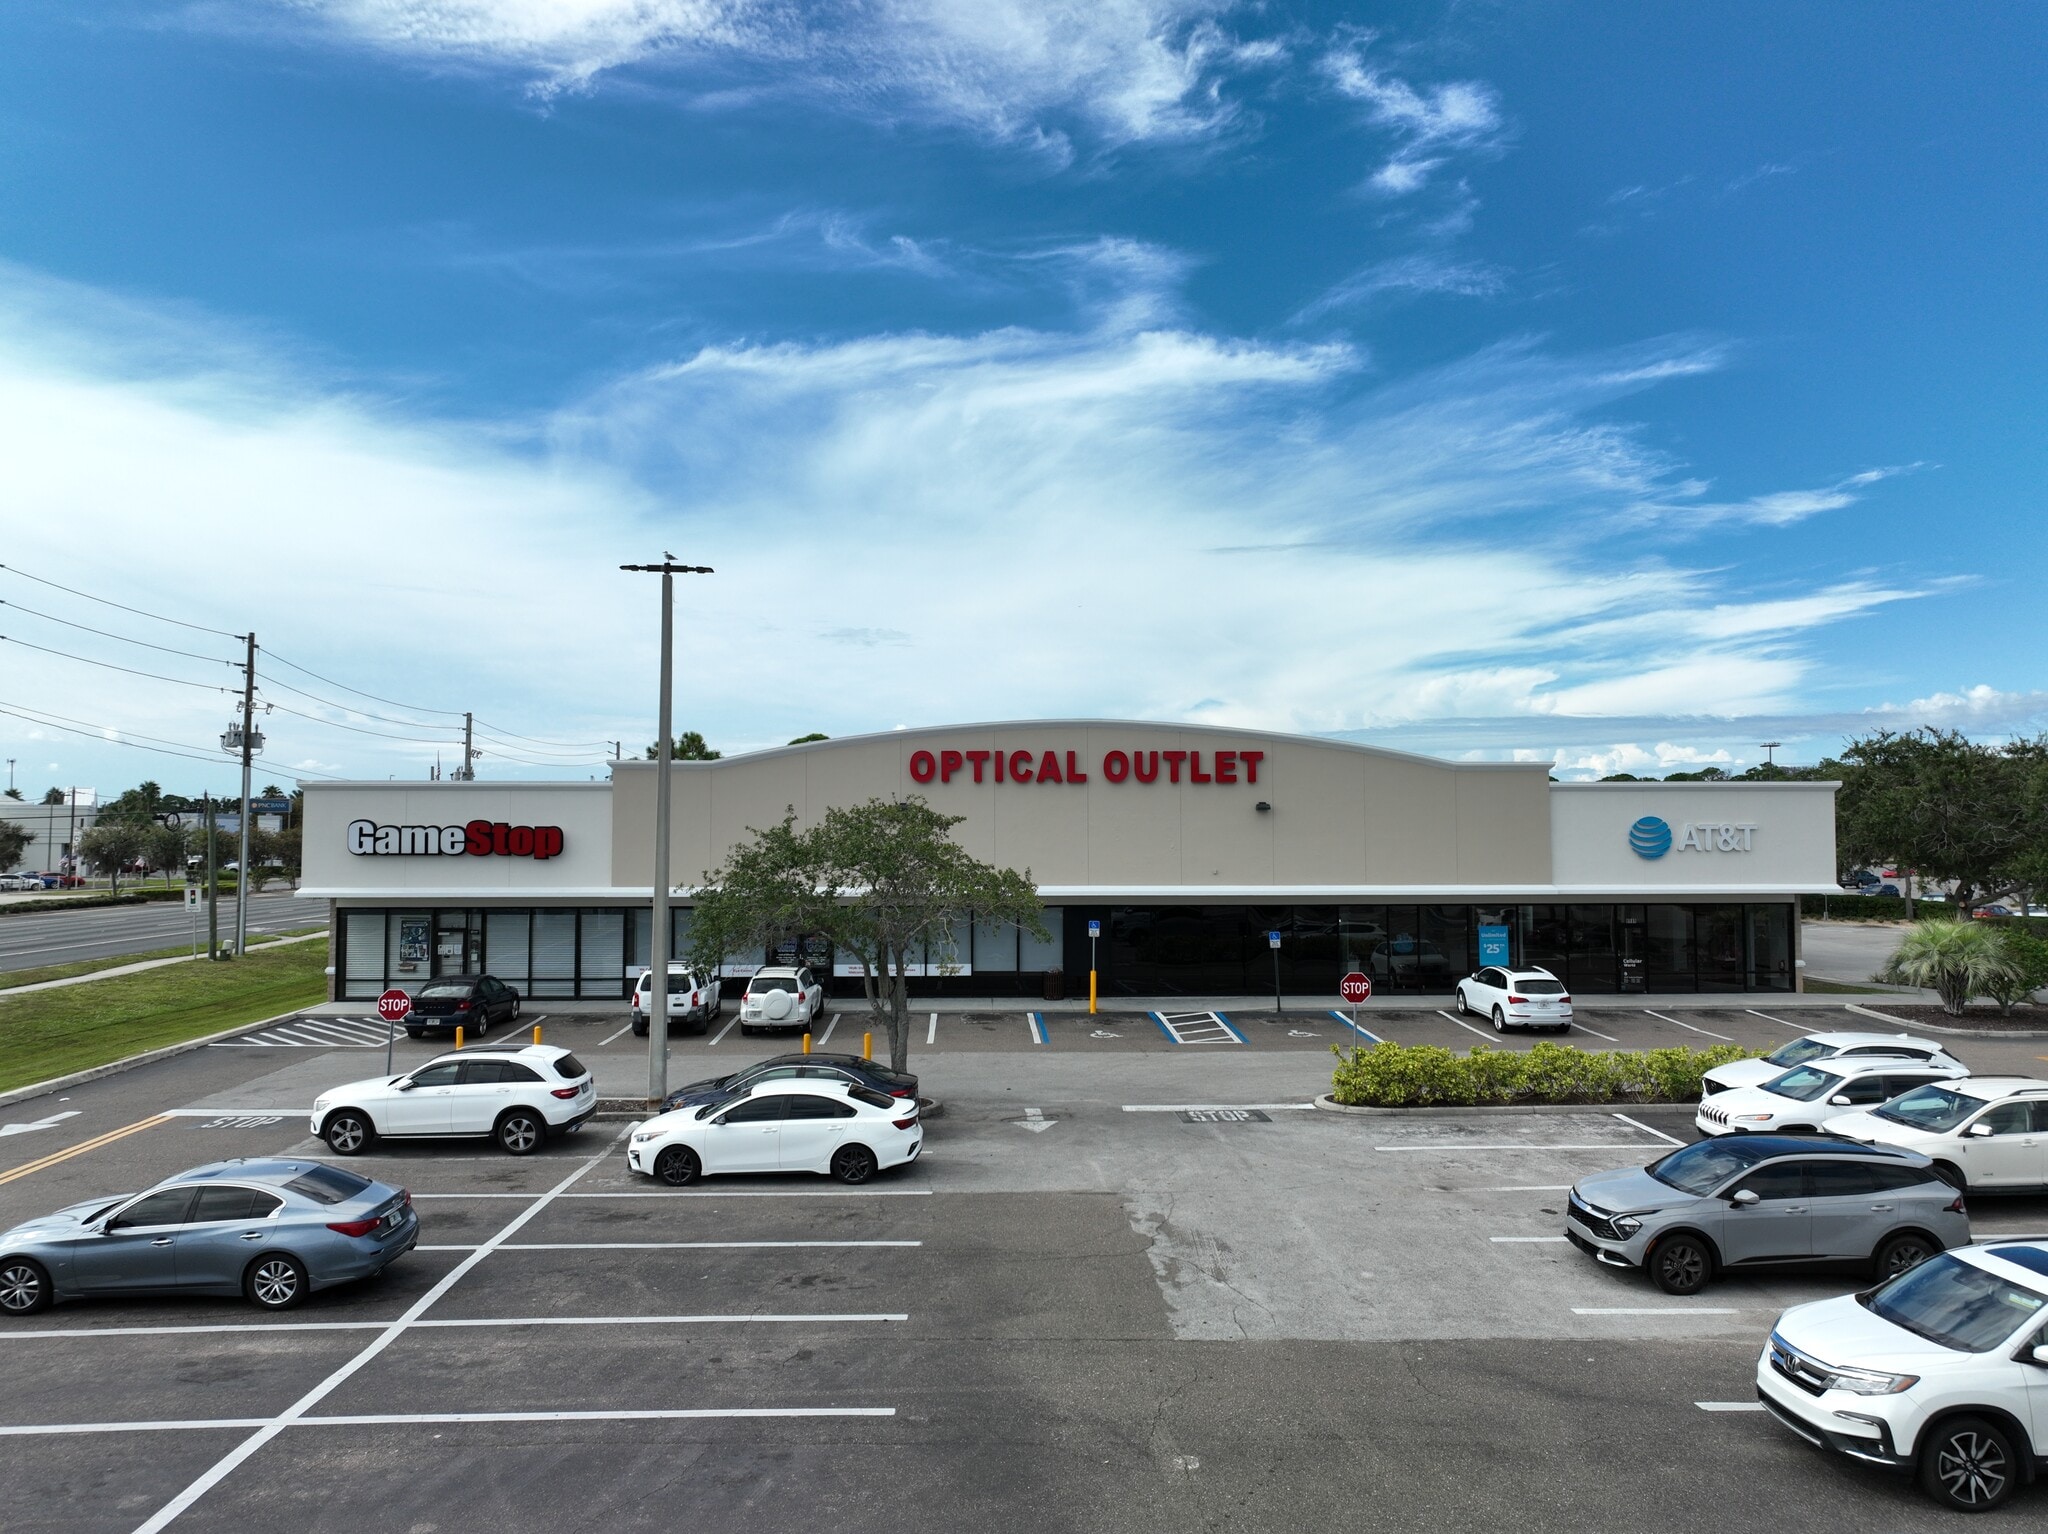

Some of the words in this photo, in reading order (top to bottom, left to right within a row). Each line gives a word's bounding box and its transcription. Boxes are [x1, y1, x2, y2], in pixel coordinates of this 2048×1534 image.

[909, 750, 1088, 784] OPTICAL
[1103, 750, 1264, 784] OUTLET
[347, 819, 564, 860] GameStop
[1678, 823, 1759, 852] AT&T
[1343, 982, 1369, 994] STOP
[380, 999, 408, 1011] STOP
[201, 1116, 283, 1129] STOP
[1188, 1110, 1250, 1122] STOP
